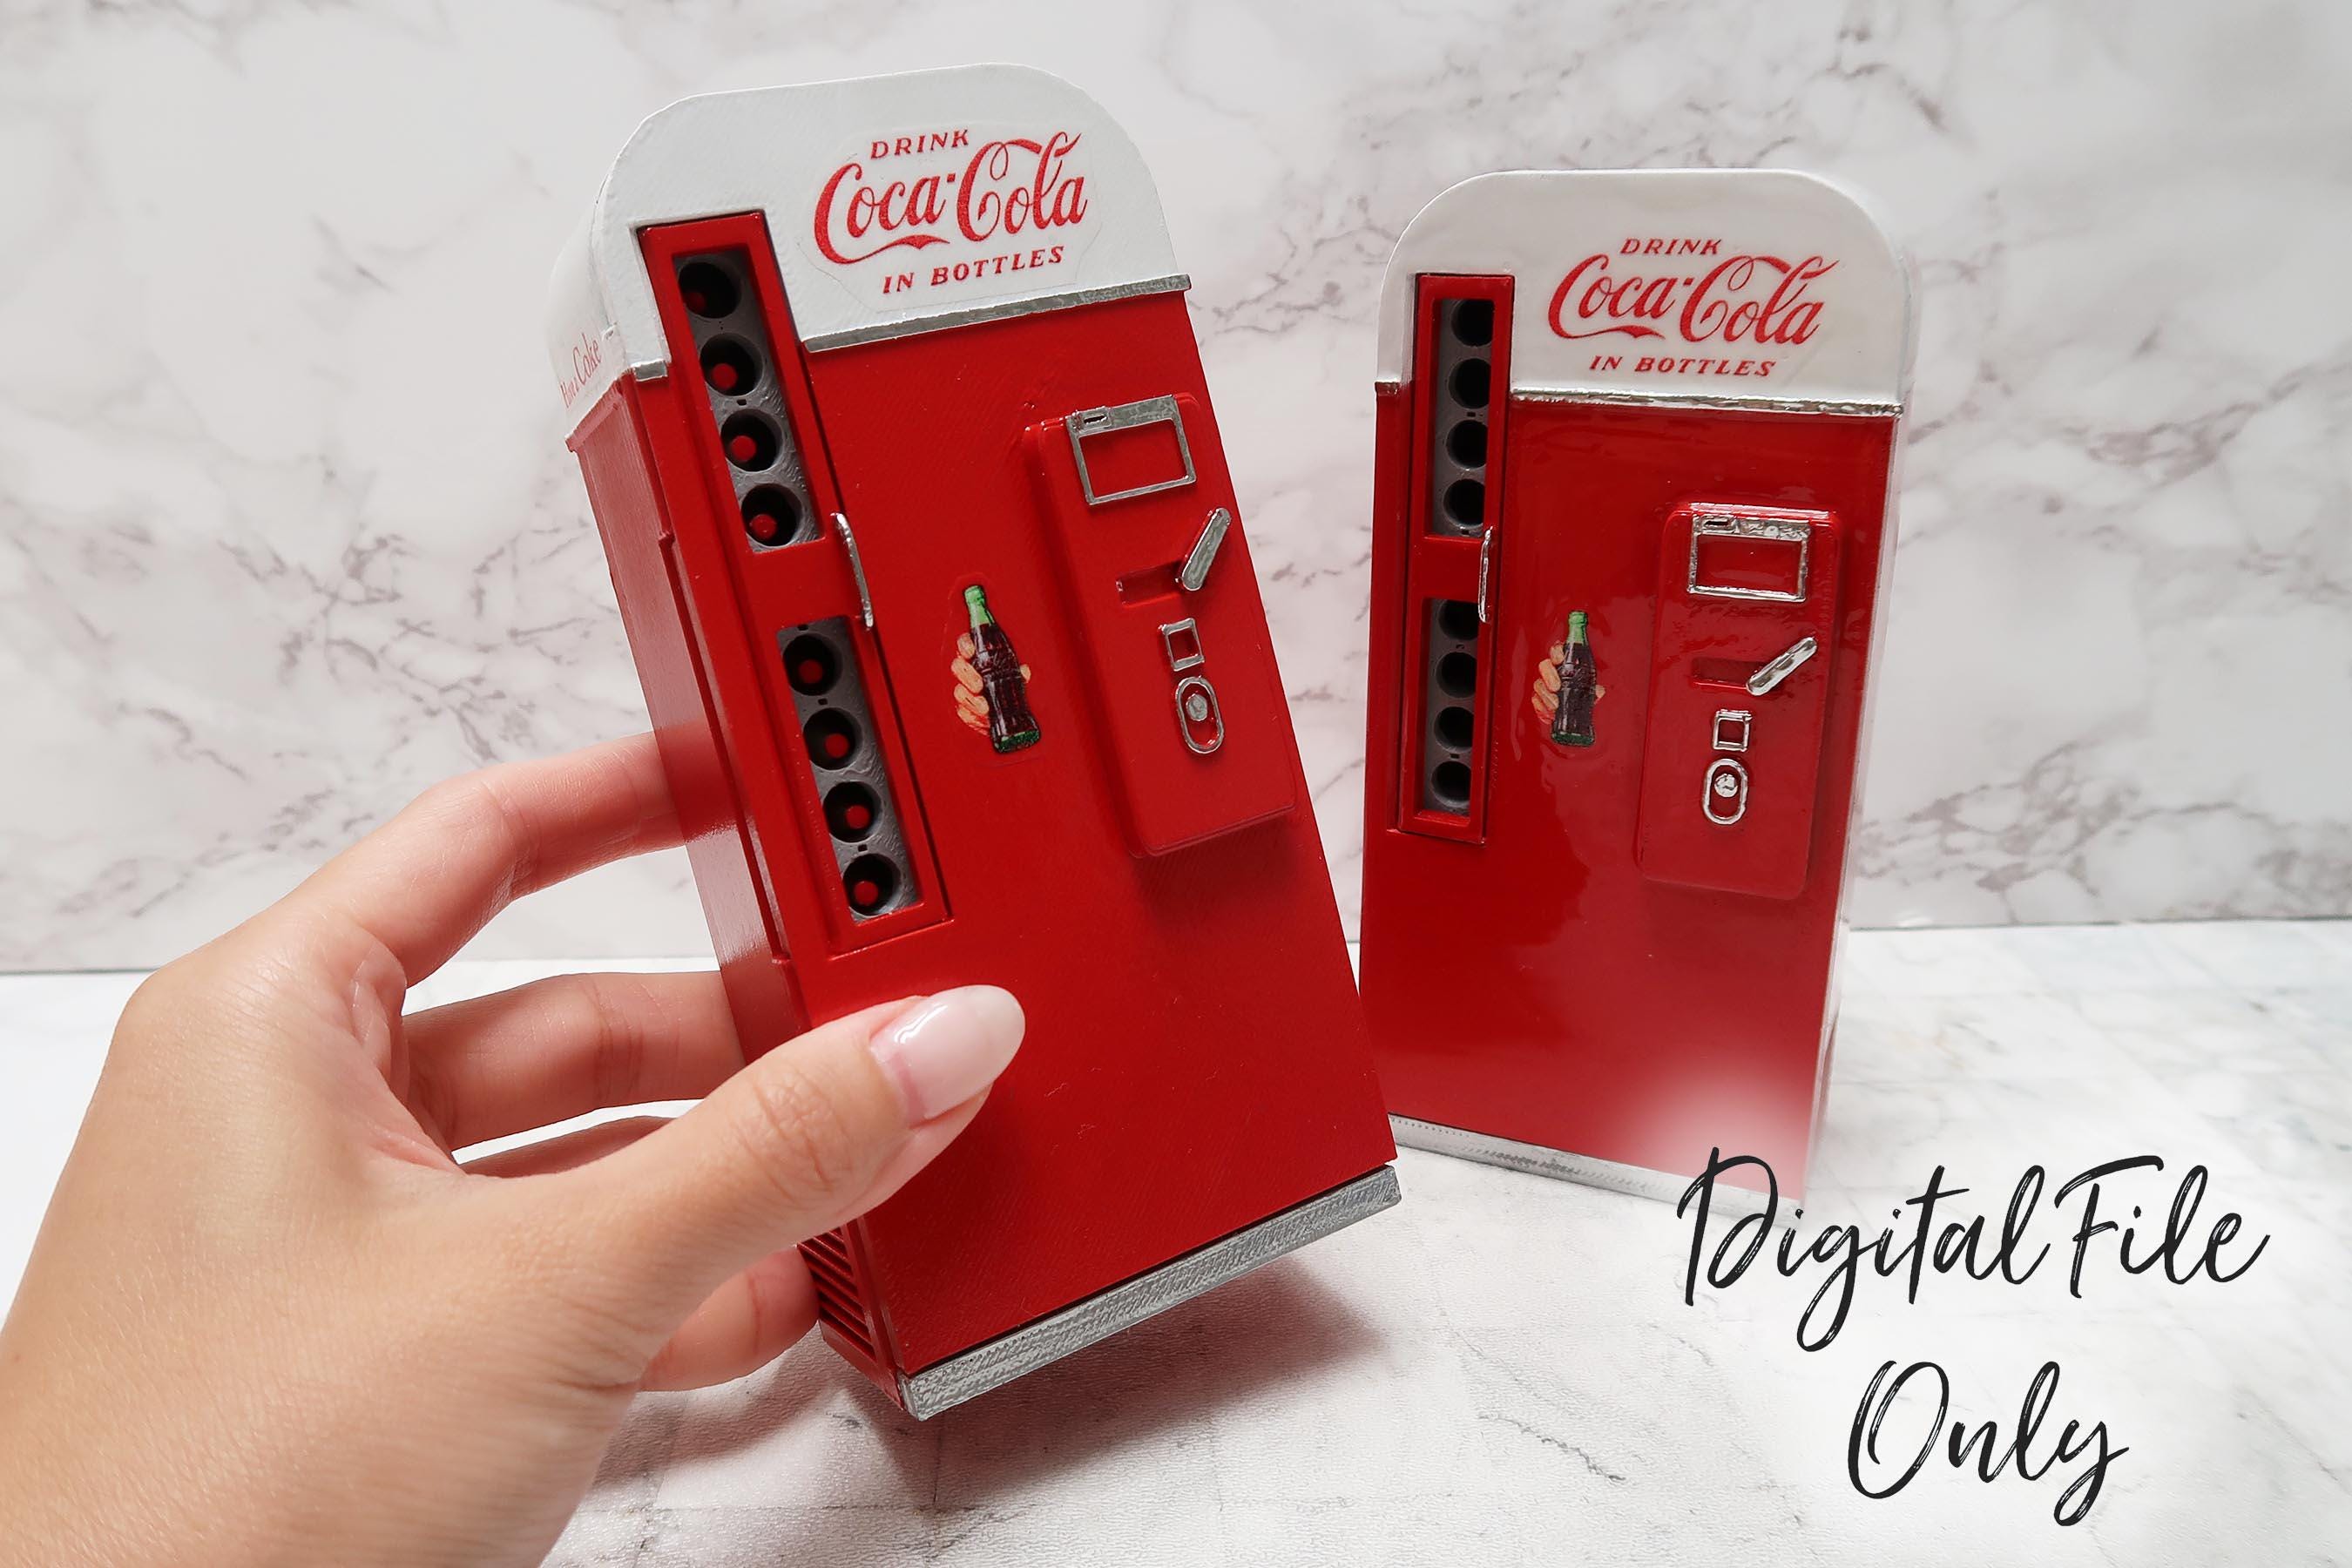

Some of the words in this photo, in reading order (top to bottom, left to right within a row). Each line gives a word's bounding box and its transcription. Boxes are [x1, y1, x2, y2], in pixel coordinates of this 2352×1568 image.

[870, 130, 970, 159] DRINK
[1619, 237, 1722, 255] DRINK
[882, 272, 915, 294] IN
[930, 245, 1064, 287] BOTTLES
[1589, 355, 1623, 371] IN
[1634, 355, 1777, 377] BOTTLES
